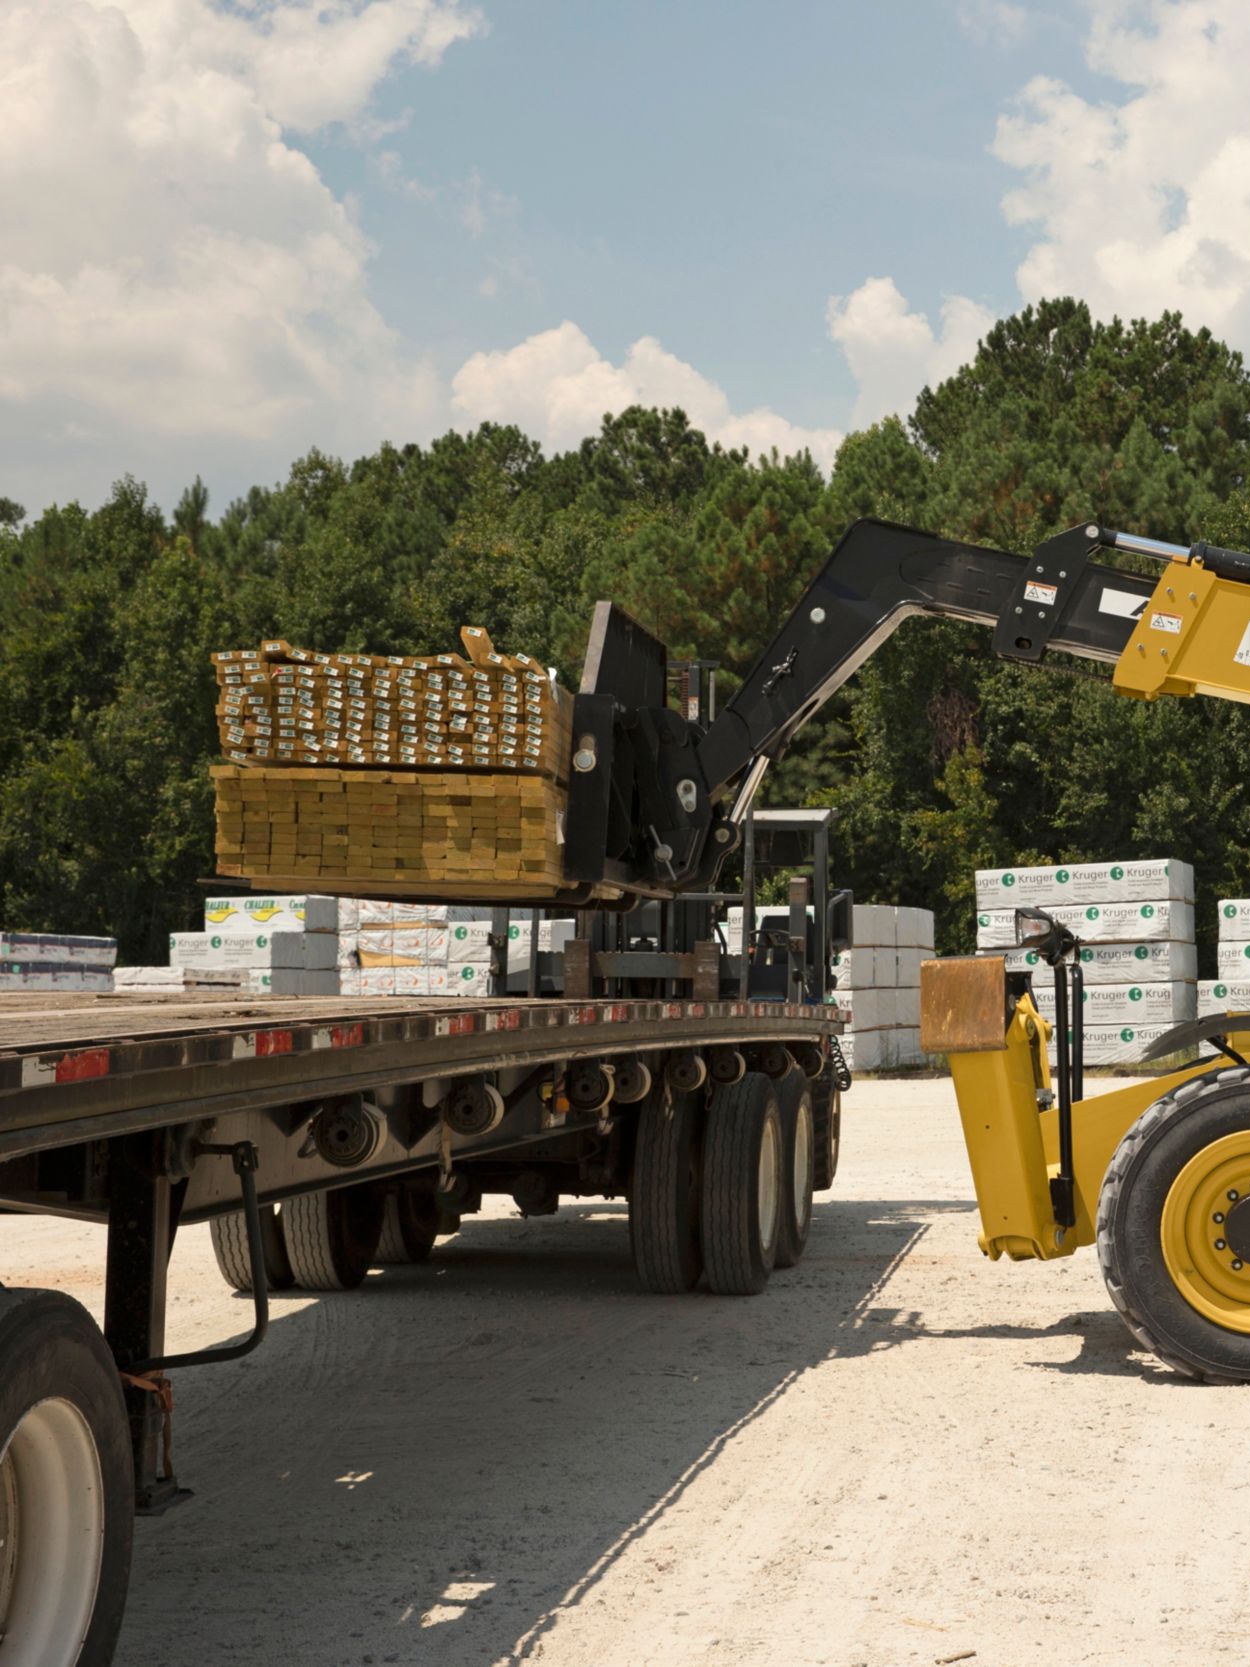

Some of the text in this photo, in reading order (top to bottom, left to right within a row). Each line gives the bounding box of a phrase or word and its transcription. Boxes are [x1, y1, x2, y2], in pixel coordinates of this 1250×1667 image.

[1072, 871, 1108, 881] Kruger
[1126, 868, 1162, 878] Kruger
[976, 879, 999, 888] uger
[1018, 874, 1053, 884] Kruger
[1102, 908, 1138, 918] Kruger
[994, 915, 1016, 924] Kru
[470, 928, 489, 938] Kru
[177, 938, 208, 948] Kruger
[224, 938, 254, 948] Kruger
[1096, 950, 1133, 961] Kruger
[1151, 947, 1169, 957] Kru
[1090, 991, 1127, 1002] Kruger
[1145, 989, 1170, 1000] Krug
[1082, 1032, 1118, 1042] Kruger
